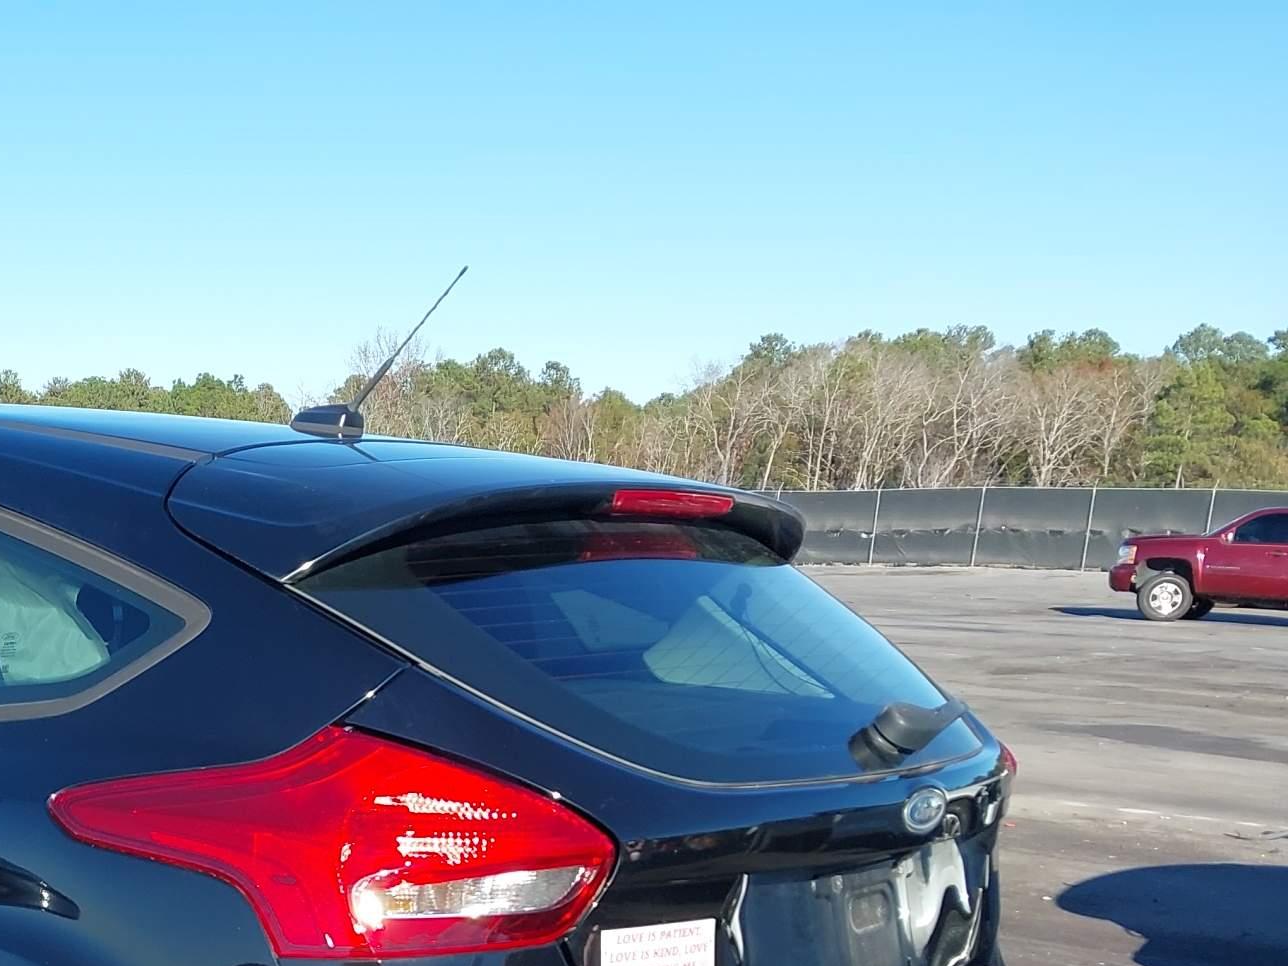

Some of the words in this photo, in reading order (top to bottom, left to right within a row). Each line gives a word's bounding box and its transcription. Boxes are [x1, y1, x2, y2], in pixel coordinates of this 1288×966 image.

[617, 932, 644, 945] LOVE
[647, 931, 656, 942] IS
[609, 951, 638, 964] LOVE
[641, 950, 650, 960] IS
[684, 943, 708, 955] LOVE
